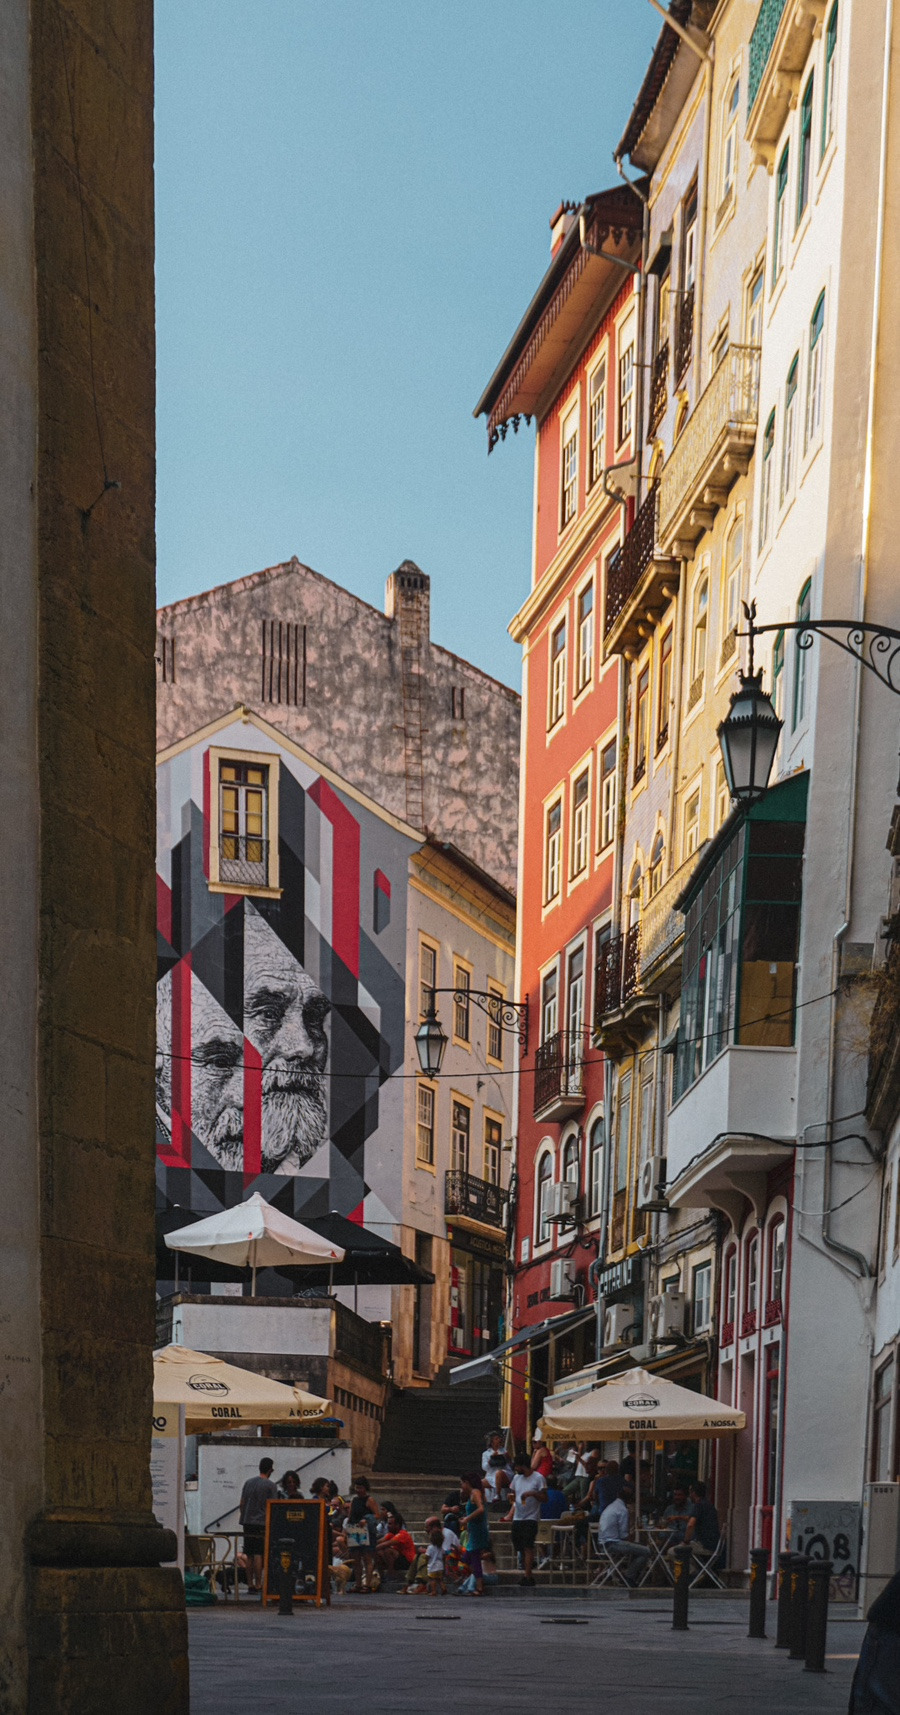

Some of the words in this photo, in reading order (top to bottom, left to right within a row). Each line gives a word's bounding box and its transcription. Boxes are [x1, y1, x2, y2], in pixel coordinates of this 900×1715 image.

[211, 1407, 242, 1417] CORAL
[629, 1420, 657, 1429] CORAL
[703, 1419, 709, 1427] À
